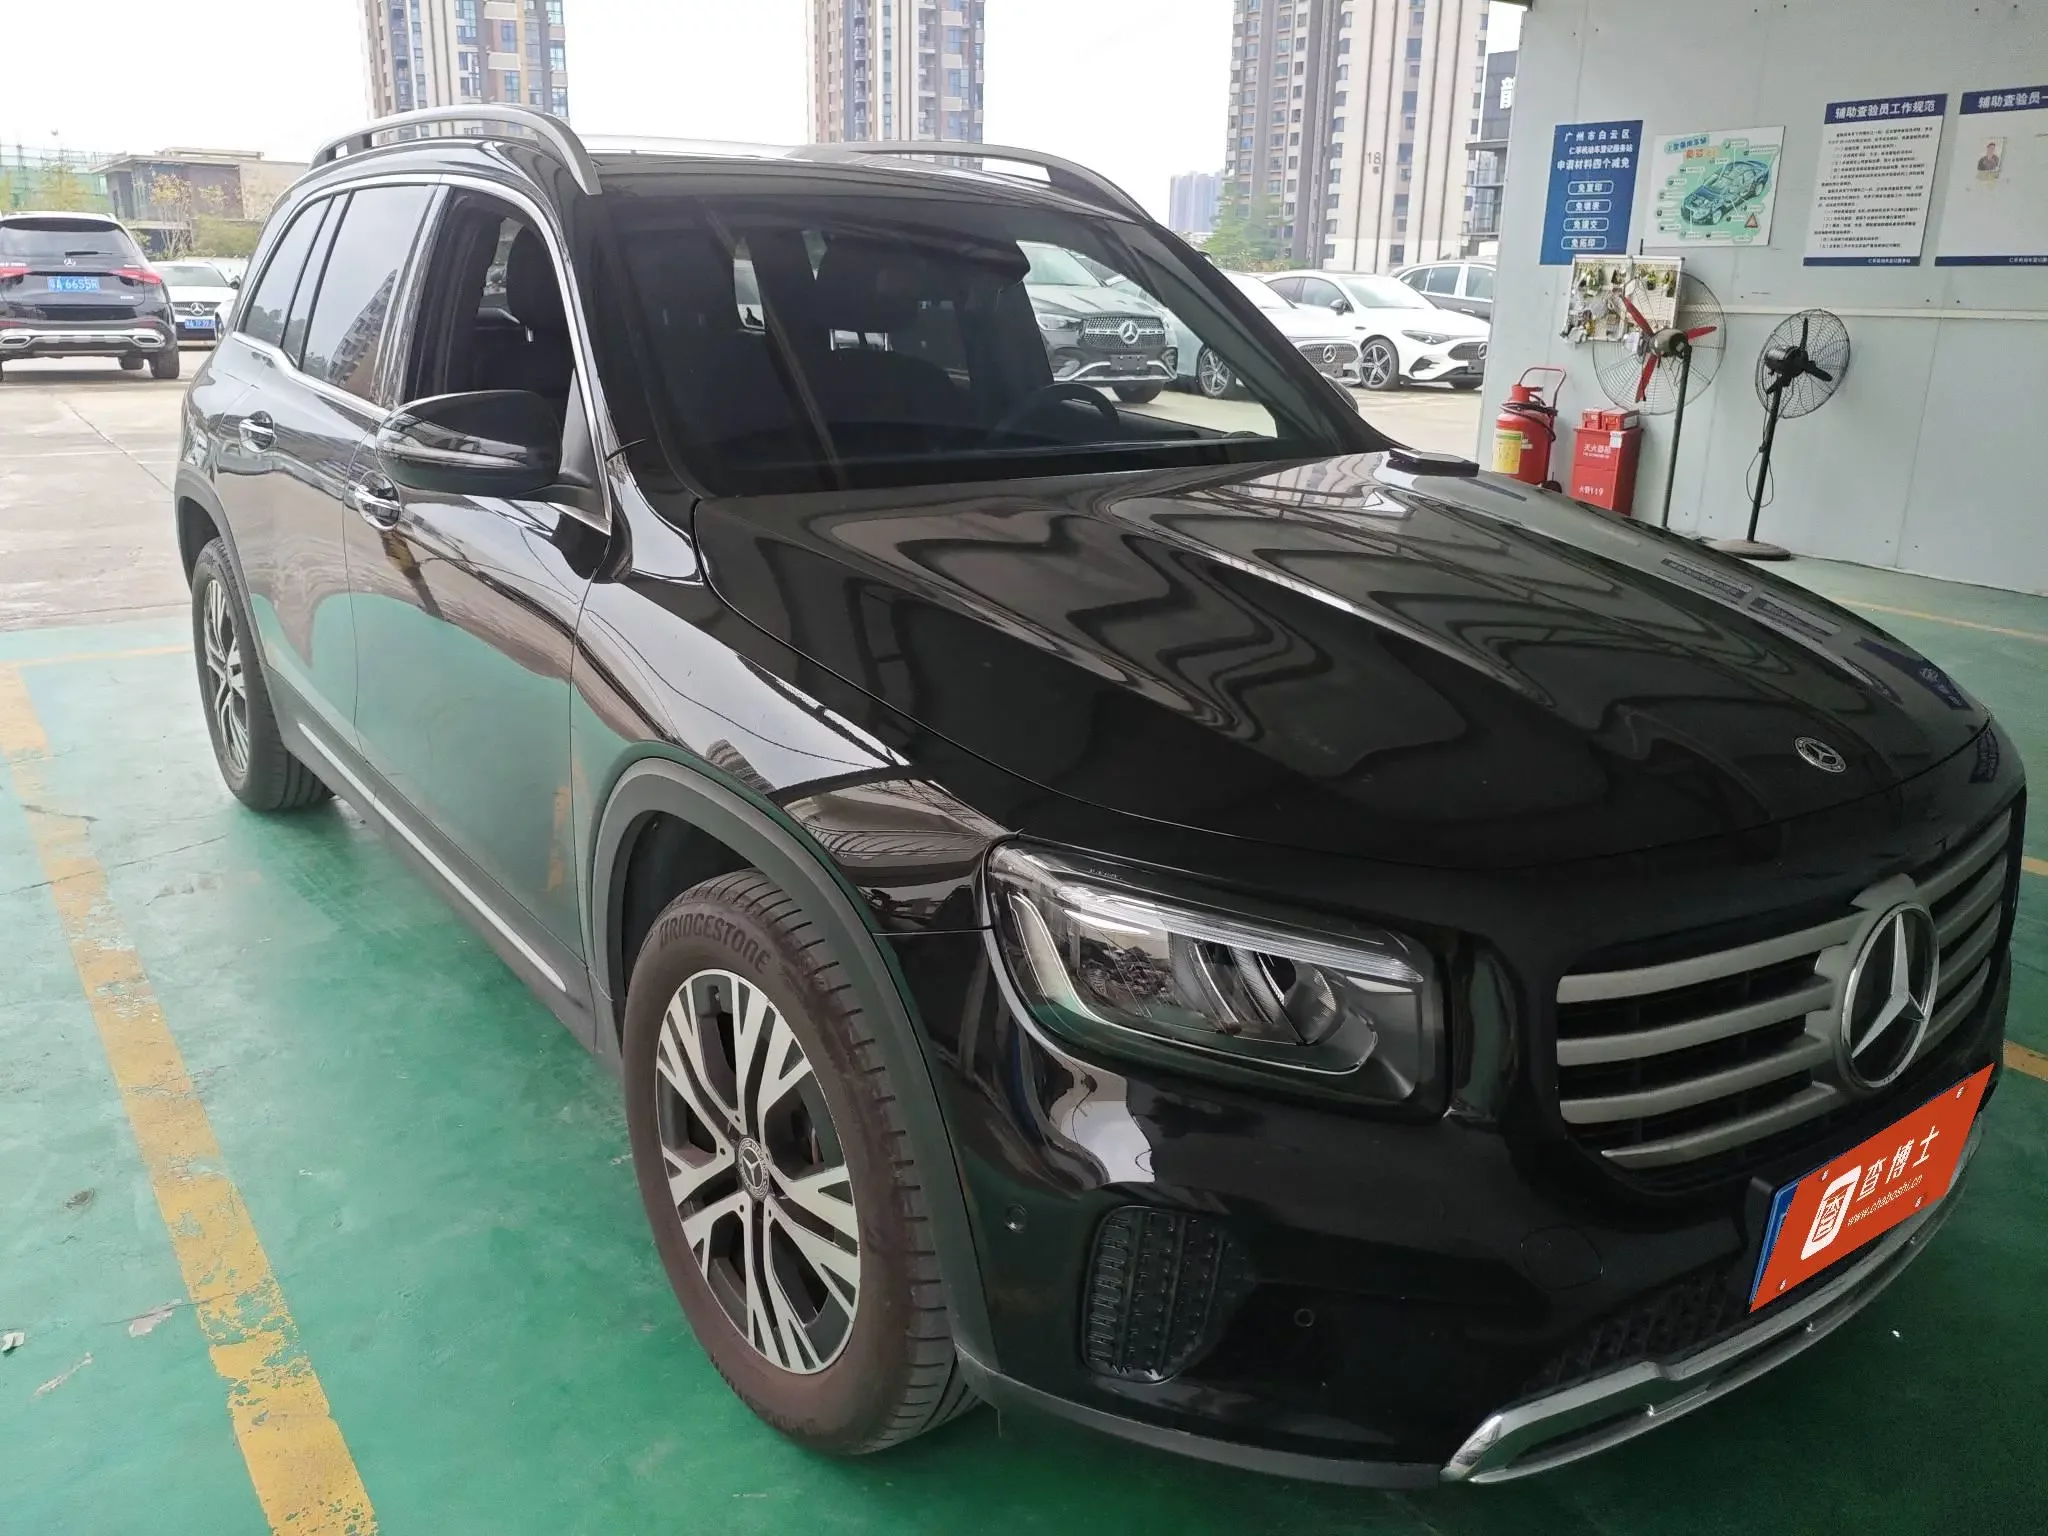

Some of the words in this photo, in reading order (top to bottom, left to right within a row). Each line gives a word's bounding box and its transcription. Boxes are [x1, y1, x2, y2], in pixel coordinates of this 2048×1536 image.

[1835, 100, 1936, 119] 辅助查验员工作规范
[1565, 129, 1630, 142] 广州市白云区
[1366, 152, 1381, 164] 18
[1557, 157, 1630, 171] 申请材料四个减免
[660, 913, 771, 974] BRIDGESTONE
